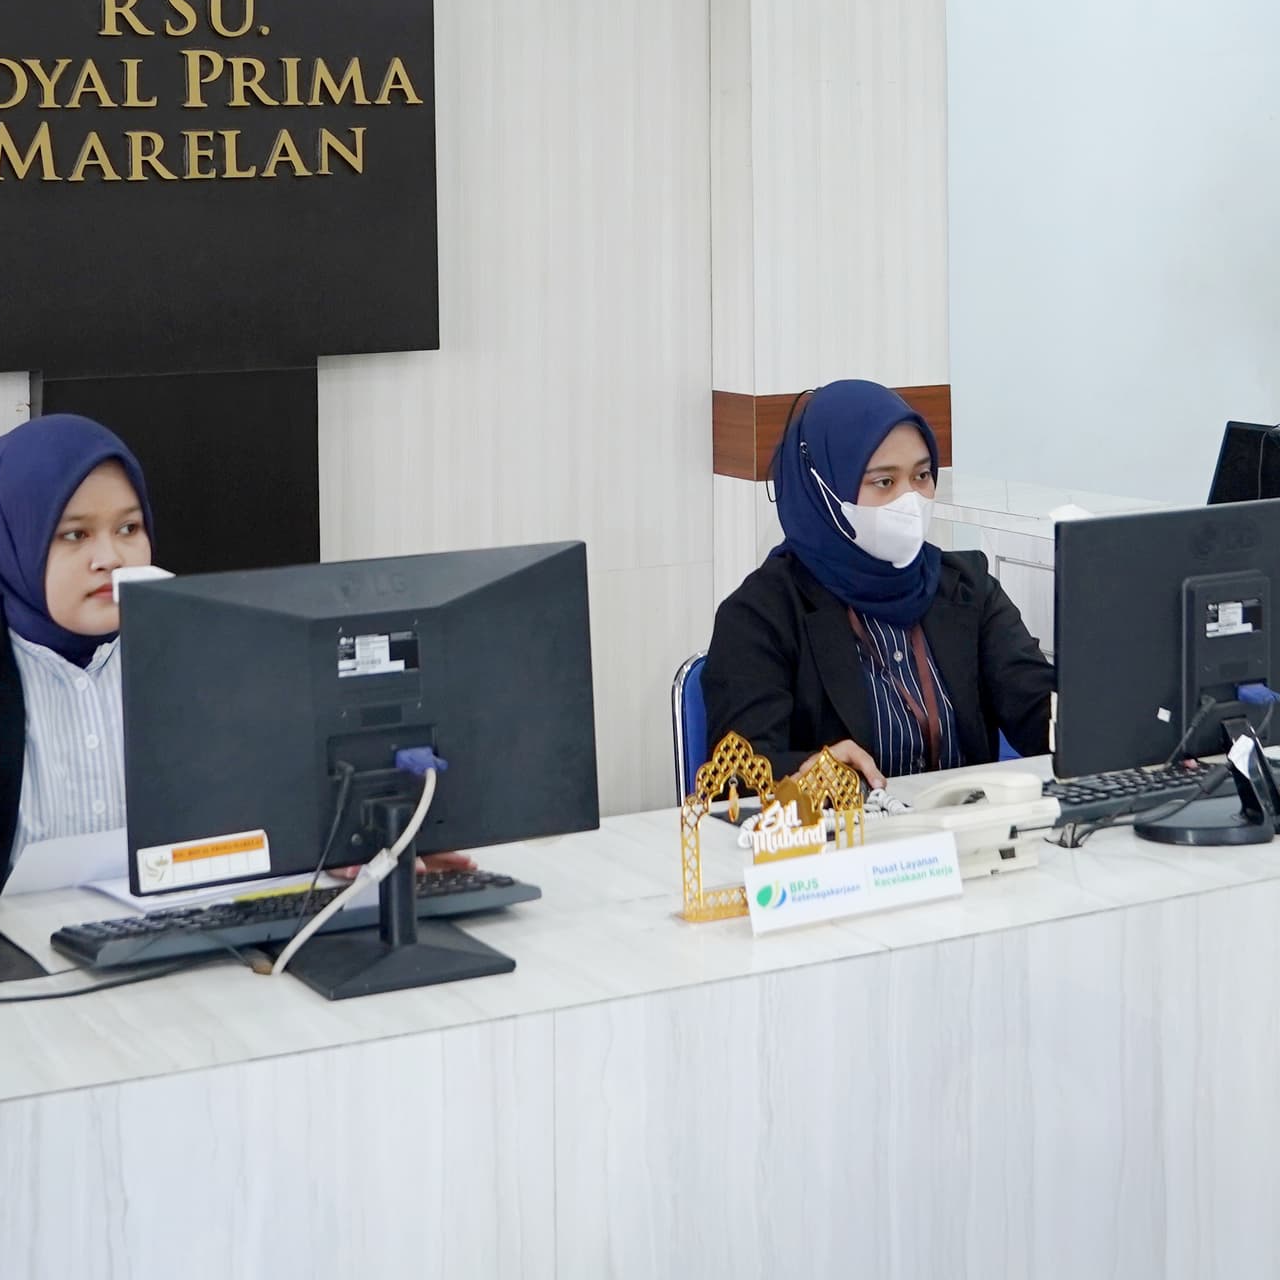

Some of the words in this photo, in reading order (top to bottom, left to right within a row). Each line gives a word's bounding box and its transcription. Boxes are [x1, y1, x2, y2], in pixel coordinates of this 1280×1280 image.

[181, 49, 424, 108] PRIMA
[872, 862, 898, 876] Pusat
[900, 855, 939, 872] Layanan
[874, 871, 927, 888] Kecelakaan
[929, 864, 953, 880] Kerja
[789, 877, 820, 894] BPJS
[791, 883, 862, 904] Ketenagakerjaan
